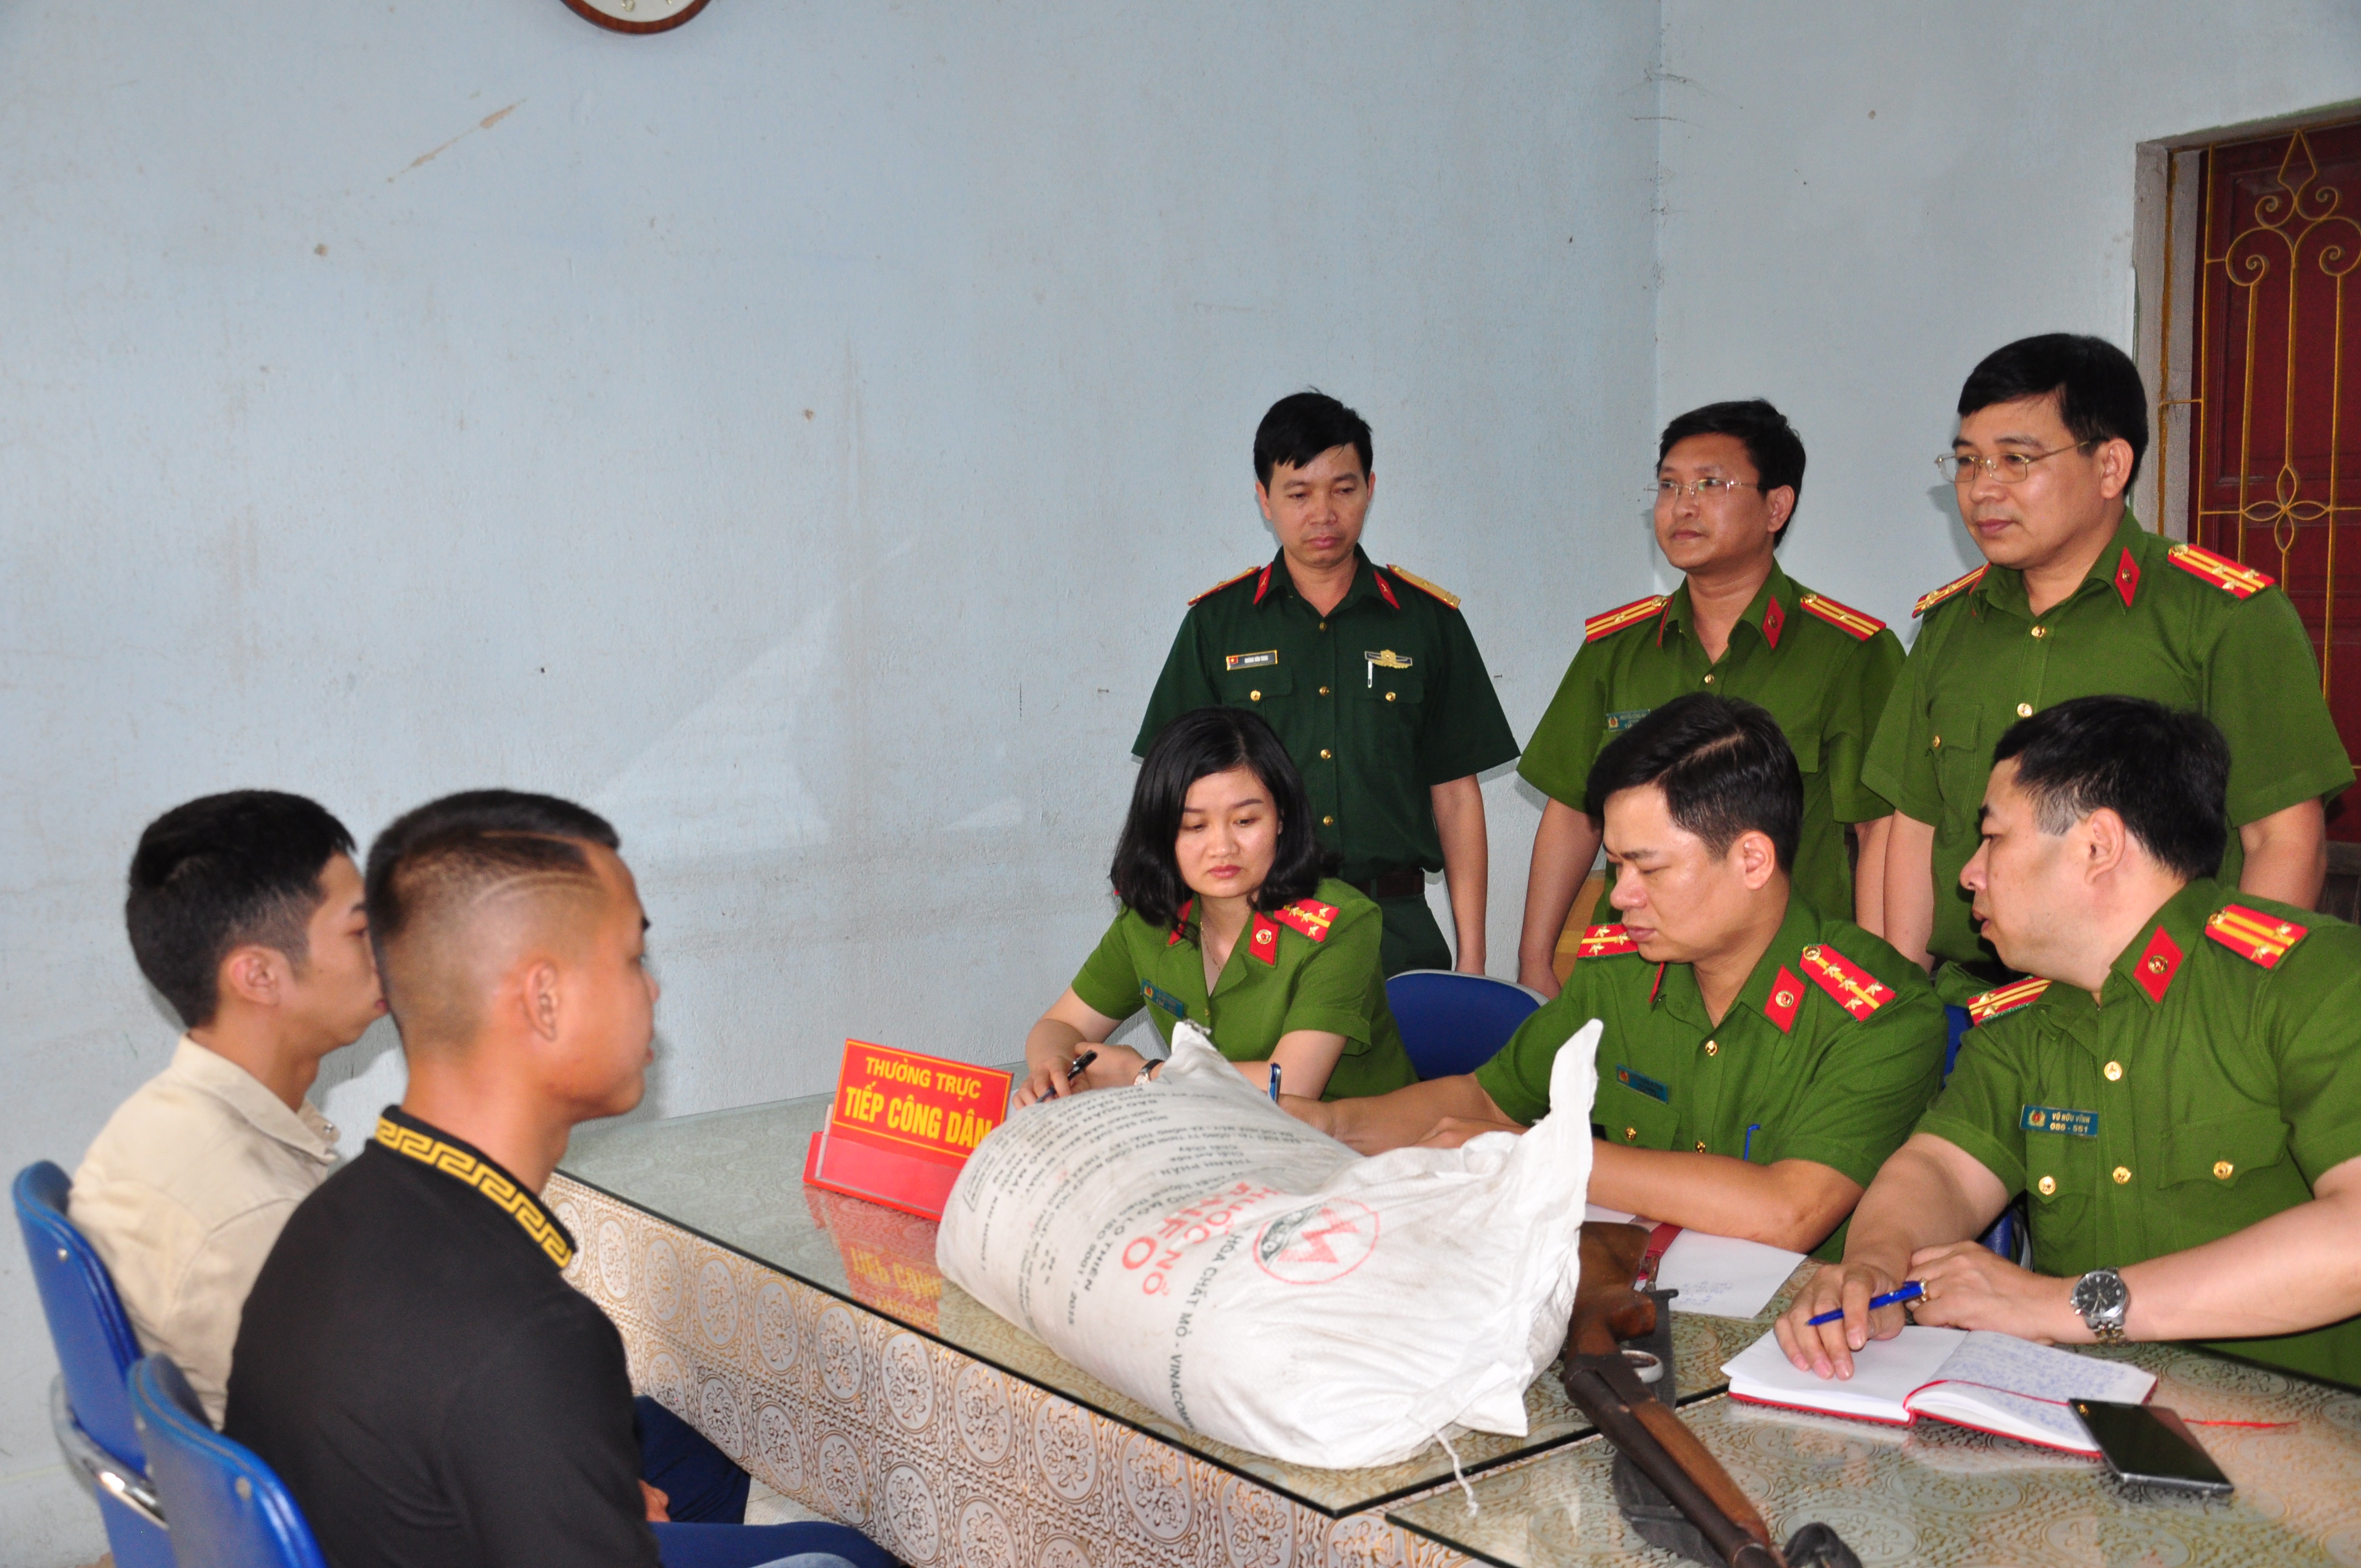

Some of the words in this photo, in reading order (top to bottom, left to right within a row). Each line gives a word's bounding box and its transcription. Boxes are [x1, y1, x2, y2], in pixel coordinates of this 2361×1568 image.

[866, 1057, 931, 1087] THƯỜNG
[936, 1072, 982, 1102] TRỰC
[845, 1081, 884, 1123] TIẾP
[887, 1094, 942, 1140] CÔNG
[945, 1108, 993, 1149] DÂN
[1185, 1188, 1279, 1244] HUỐC
[1144, 1250, 1182, 1295] NỔ
[1176, 1311, 1192, 1337] MỎ
